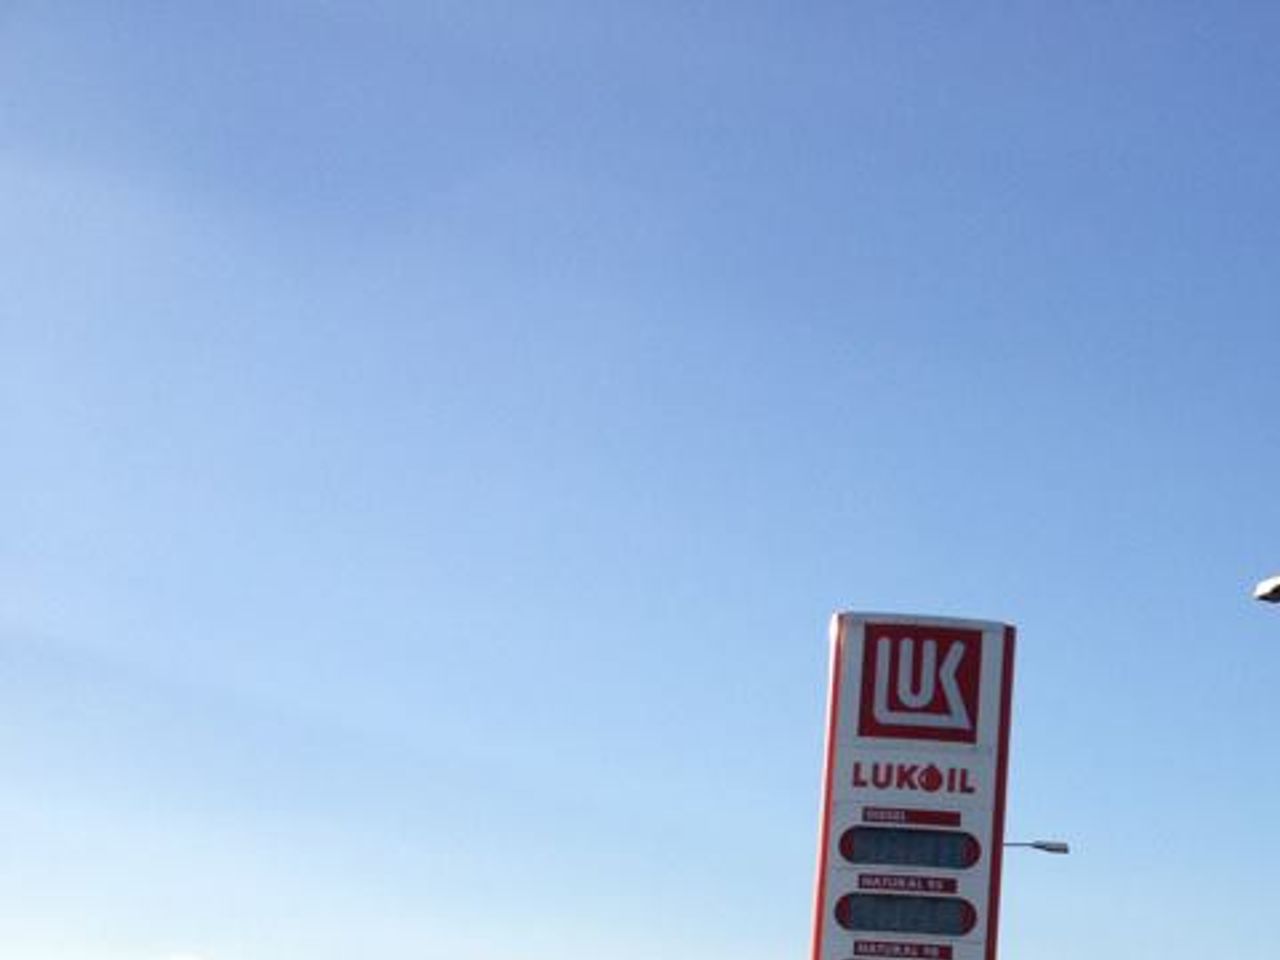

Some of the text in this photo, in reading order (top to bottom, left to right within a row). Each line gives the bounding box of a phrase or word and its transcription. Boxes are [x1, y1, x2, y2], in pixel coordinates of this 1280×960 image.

[873, 636, 974, 731] LUK
[852, 761, 976, 794] LUKOIL
[861, 876, 922, 890] NATURAL
